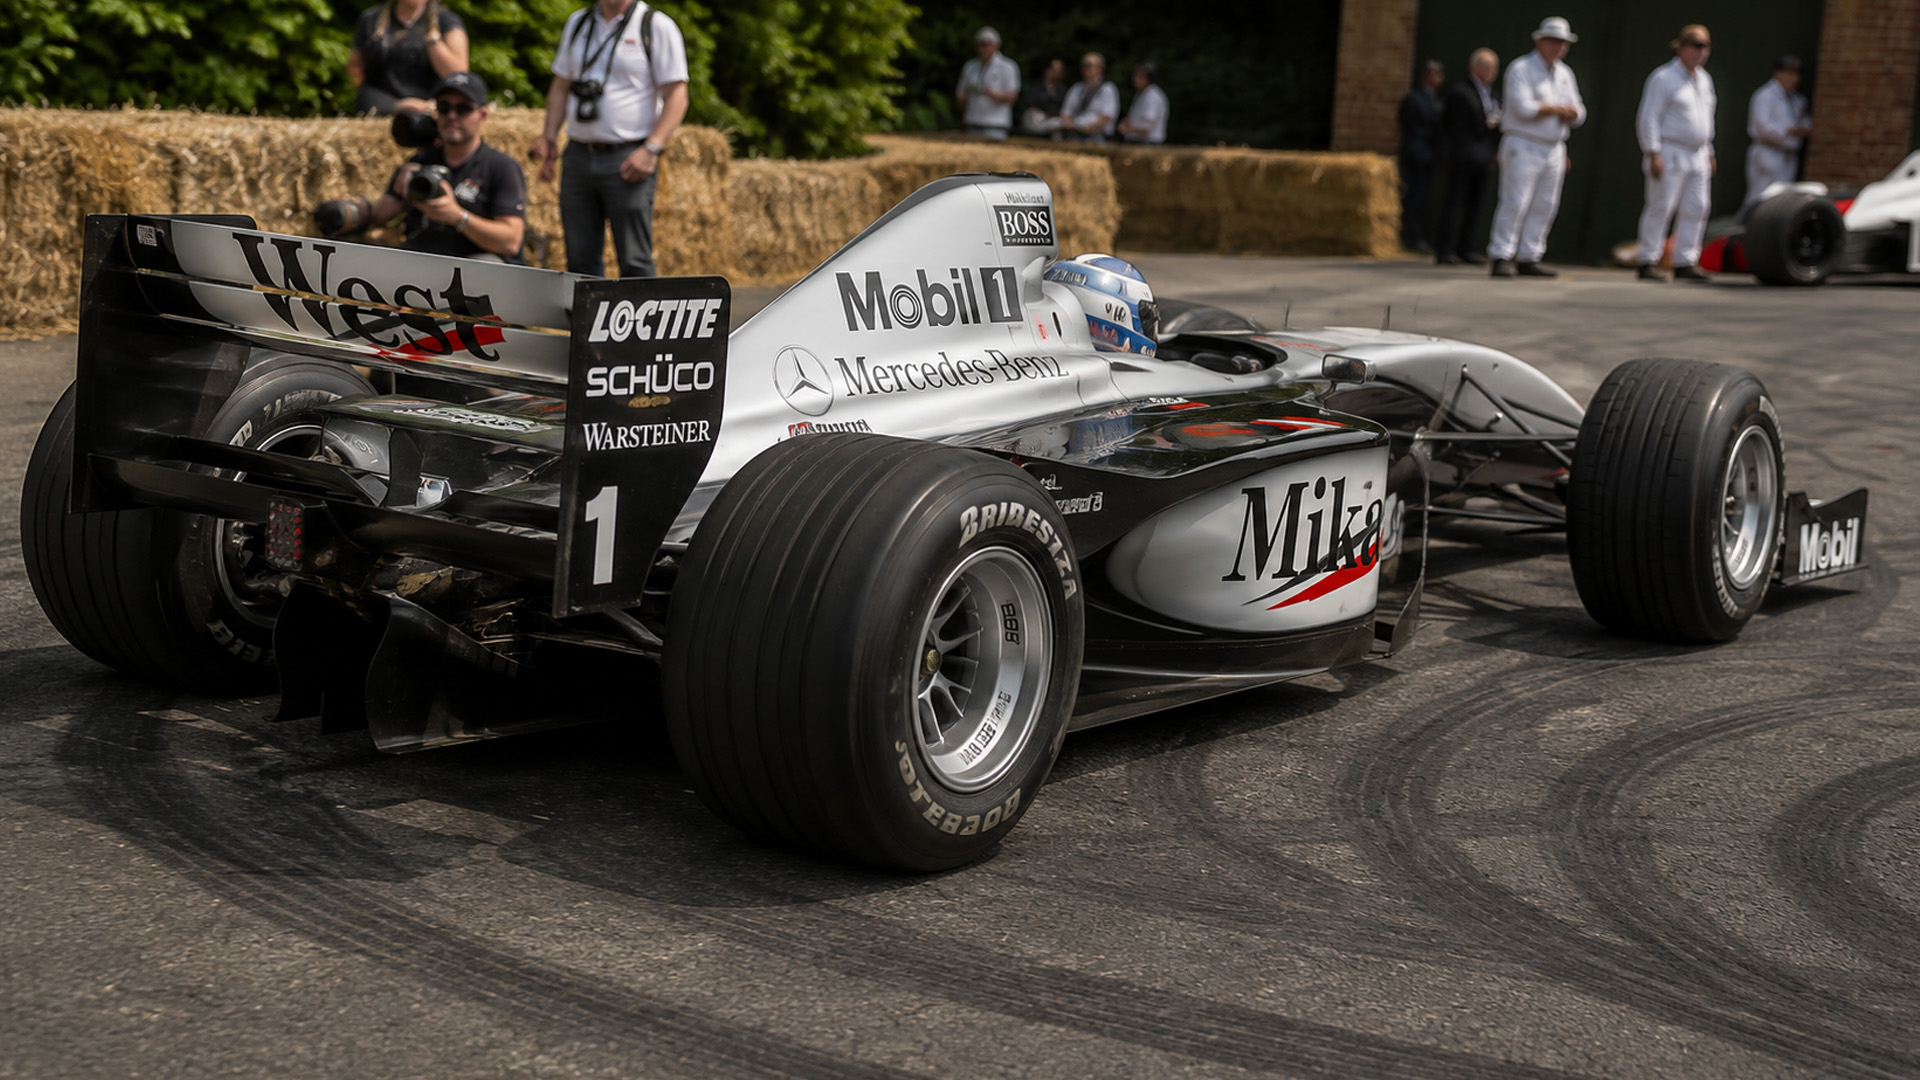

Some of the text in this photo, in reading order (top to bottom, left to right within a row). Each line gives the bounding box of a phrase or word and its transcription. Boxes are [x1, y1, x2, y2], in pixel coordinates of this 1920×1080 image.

[999, 210, 1050, 237] BOSS
[232, 233, 500, 362] West
[588, 299, 722, 342] LOCTITE
[836, 268, 982, 332] Mobil
[585, 353, 715, 397] SCHÜCO
[834, 349, 1069, 398] Mercedes-Benz
[585, 486, 618, 585] 1
[1221, 476, 1384, 582] Mika
[1799, 517, 1860, 574] Mobil
